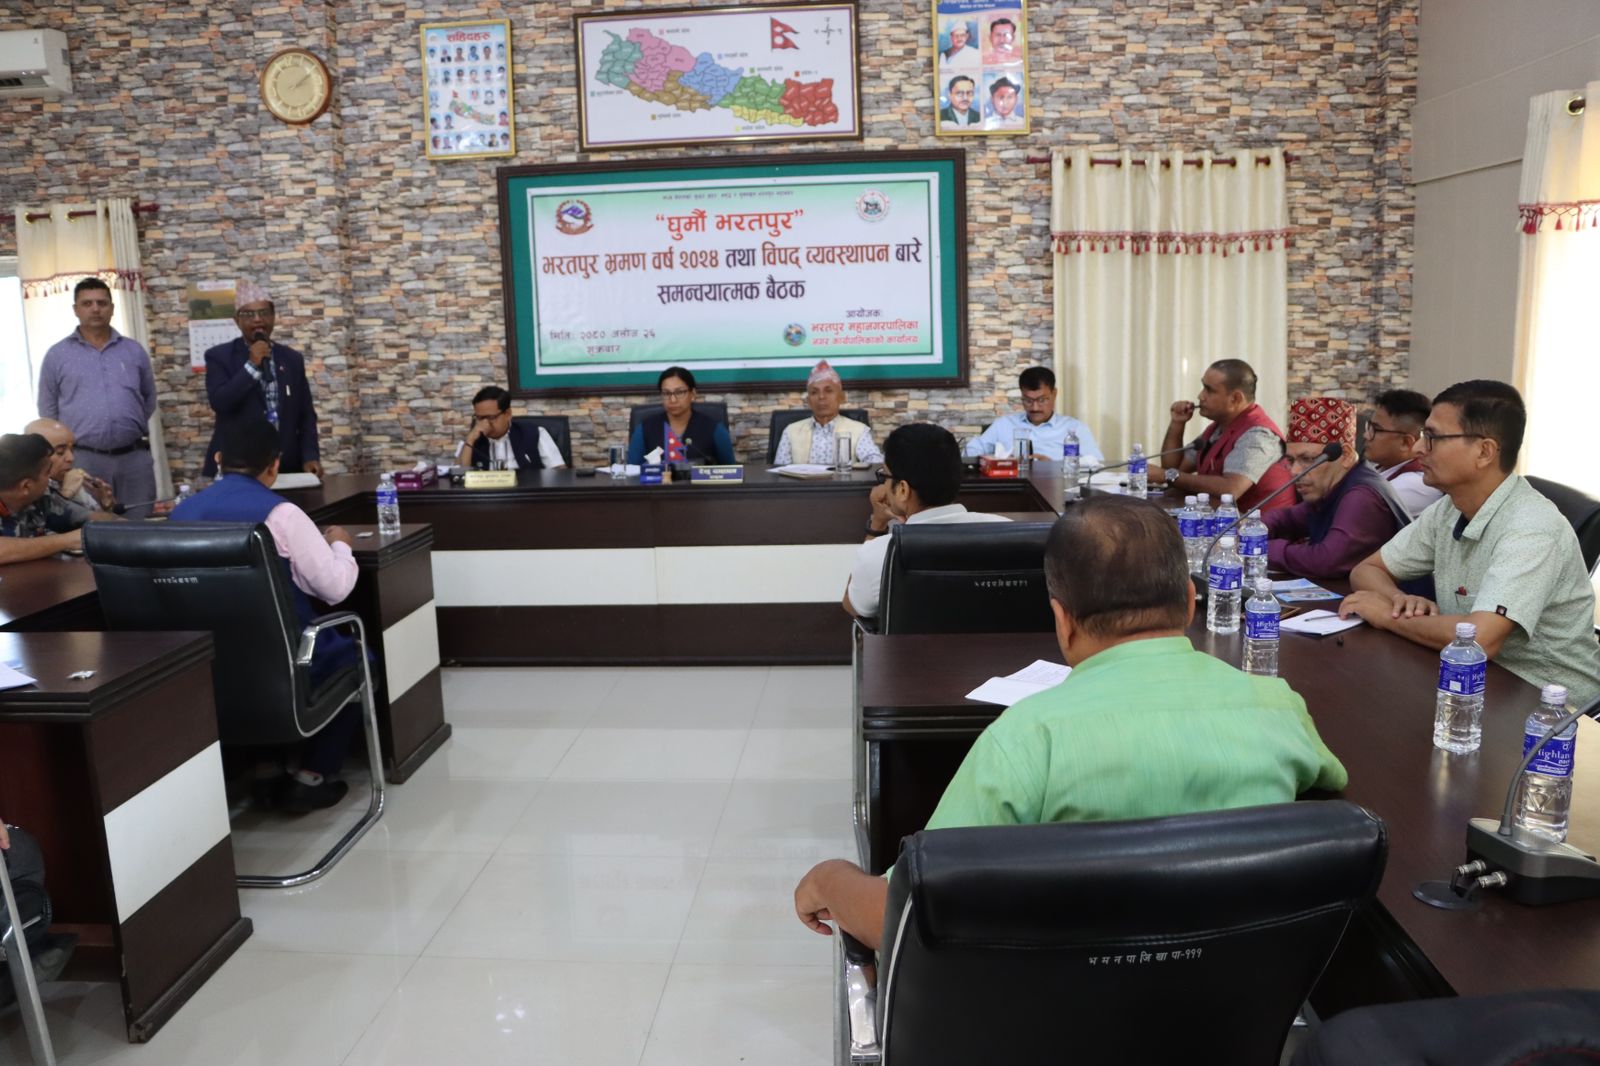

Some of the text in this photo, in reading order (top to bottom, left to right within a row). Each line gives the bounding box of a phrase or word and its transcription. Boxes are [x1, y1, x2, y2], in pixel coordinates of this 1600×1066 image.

[542, 237, 923, 279] भरतपुर भ्रमण वर्ष २०२४ तथा विपद् व्यवस्थापन बारे
[656, 274, 806, 305] समन्वयात्मक बैठक
